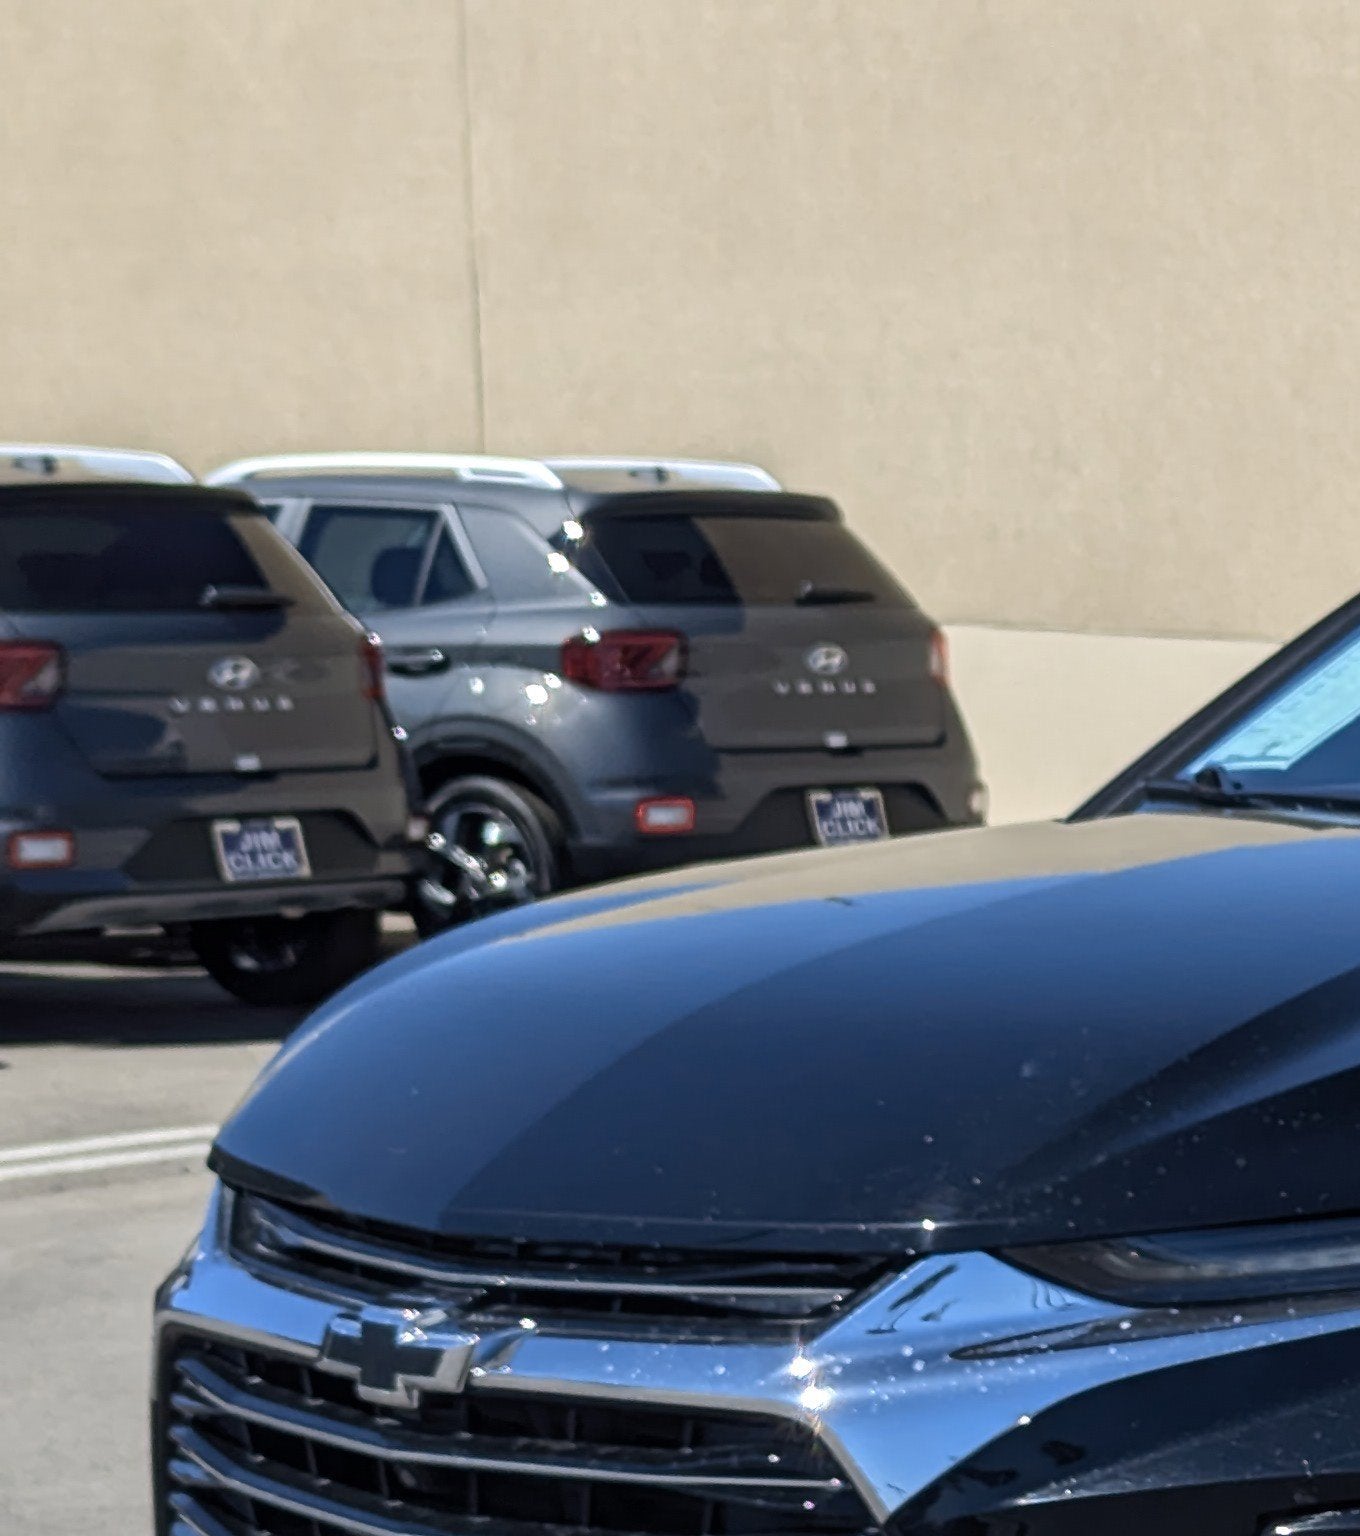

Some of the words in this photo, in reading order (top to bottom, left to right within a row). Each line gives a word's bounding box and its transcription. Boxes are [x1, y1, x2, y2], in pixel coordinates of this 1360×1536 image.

[834, 800, 866, 818] JIM
[821, 819, 882, 837] CLICK
[240, 830, 282, 852] JIM
[228, 852, 299, 873] CLICK
